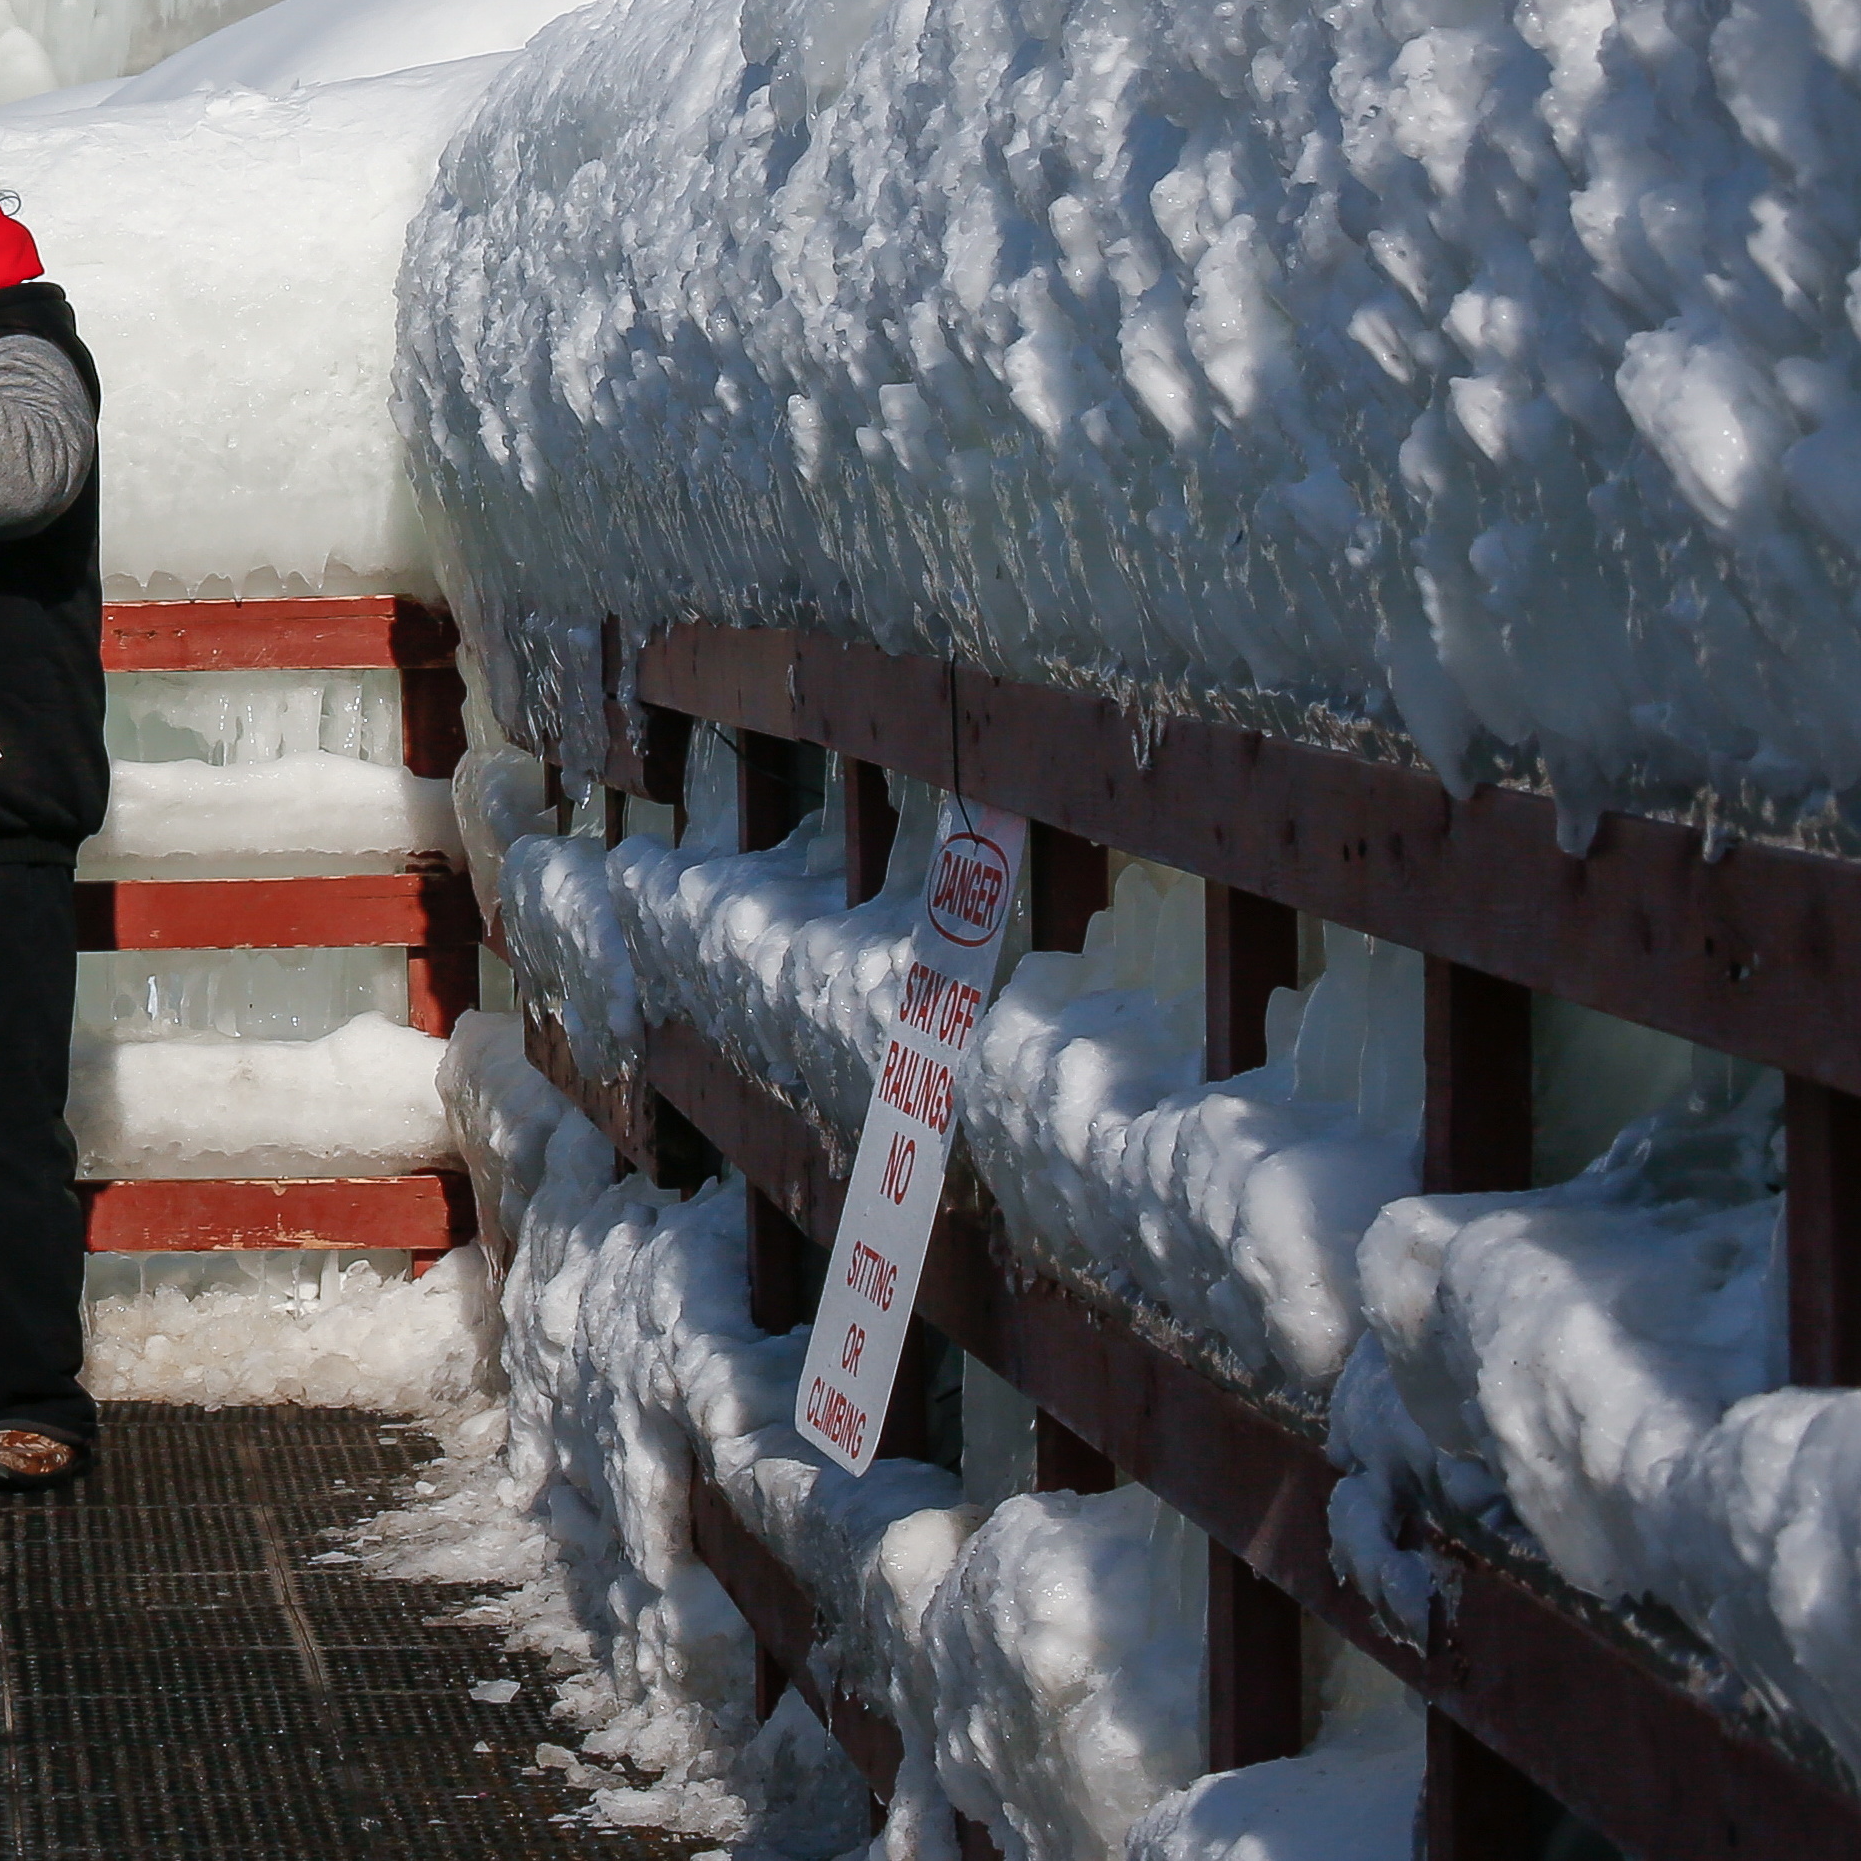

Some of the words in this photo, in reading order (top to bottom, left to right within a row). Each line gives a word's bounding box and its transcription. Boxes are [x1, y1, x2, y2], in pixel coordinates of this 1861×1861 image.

[932, 850, 1003, 930] DANGER
[899, 961, 946, 1033] STAY
[939, 980, 982, 1050] OFF
[878, 1039, 955, 1135] RAILINGS
[879, 1131, 916, 1206] NO
[846, 1240, 898, 1311] SITTING
[841, 1323, 866, 1377] OR
[806, 1376, 867, 1459] CLIMBING
